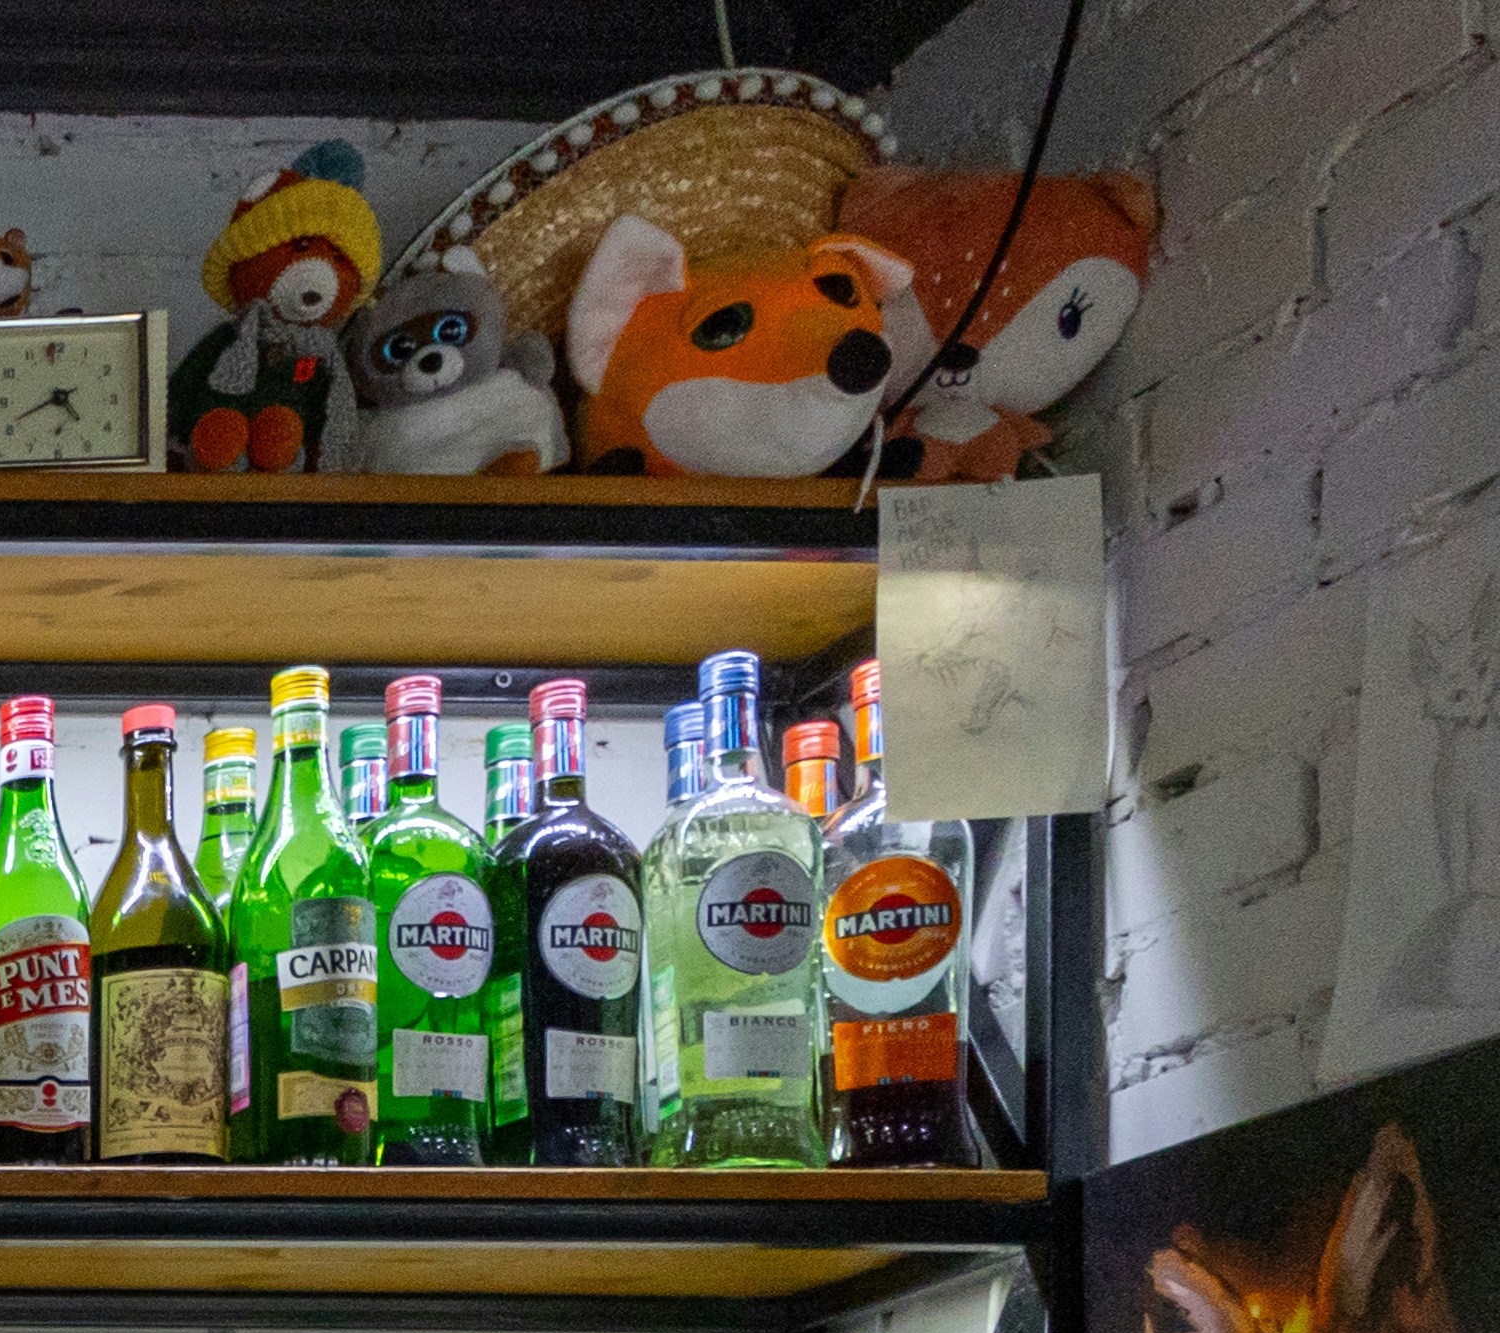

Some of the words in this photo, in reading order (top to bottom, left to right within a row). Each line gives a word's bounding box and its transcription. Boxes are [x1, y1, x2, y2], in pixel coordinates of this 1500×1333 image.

[709, 903, 811, 927] MARTINI
[838, 903, 950, 937] MARTINI
[400, 927, 488, 948] MARTINI
[553, 924, 638, 948] MARTINI
[1, 992, 13, 1008] E
[17, 976, 89, 1012] MES
[729, 1015, 797, 1027] BIANCO
[862, 1019, 930, 1033] FIERO
[422, 1034, 474, 1046] ROSSO
